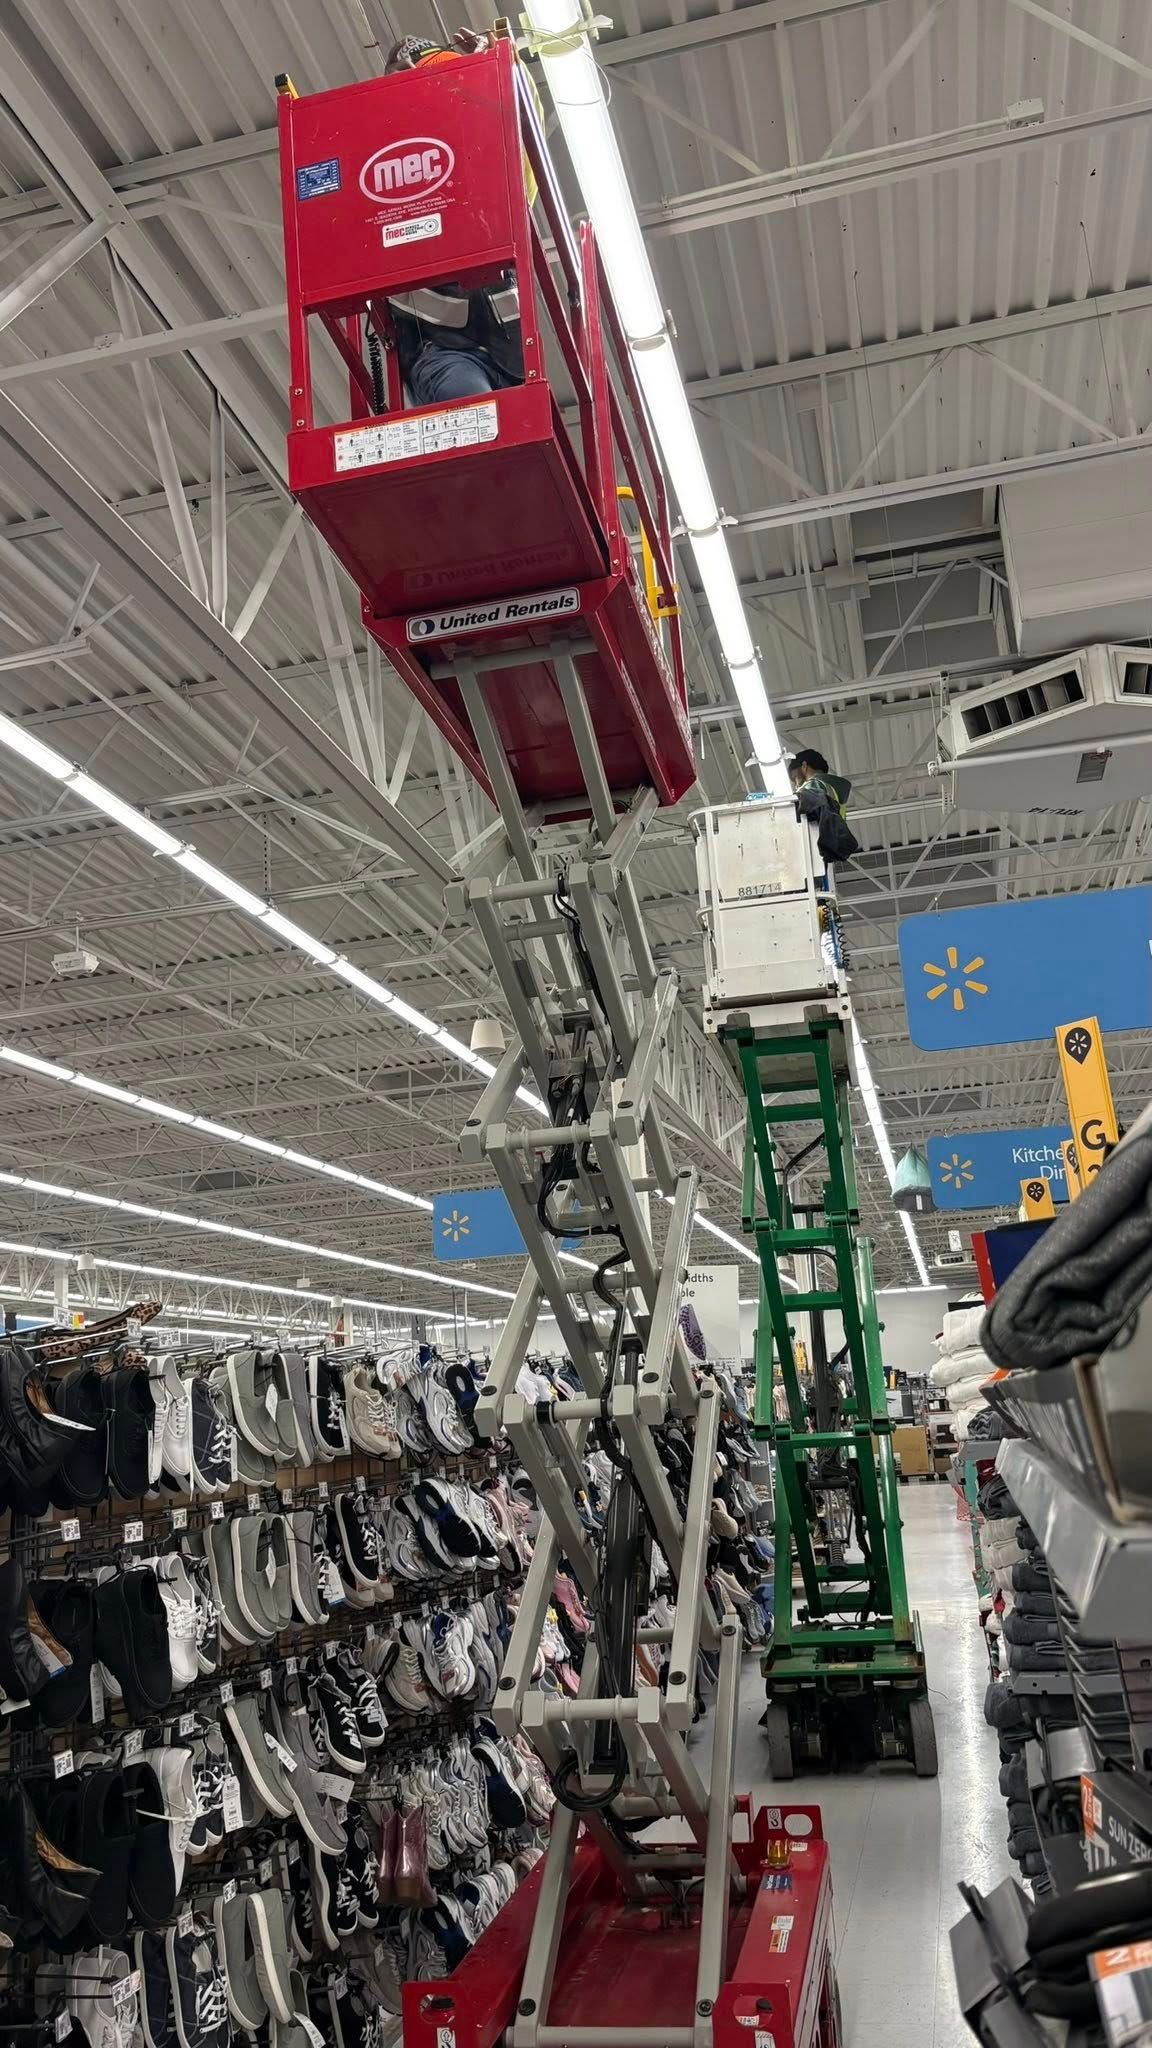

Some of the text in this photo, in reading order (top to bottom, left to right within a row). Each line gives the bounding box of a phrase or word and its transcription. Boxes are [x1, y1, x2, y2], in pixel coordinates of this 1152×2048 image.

[439, 595, 575, 631] United Rentals
[738, 882, 781, 896] 881714
[1080, 1119, 1107, 1151] G
[1012, 1145, 1064, 1163] Kitche
[687, 1272, 714, 1283] idths
[1107, 1815, 1128, 1850] SUN
